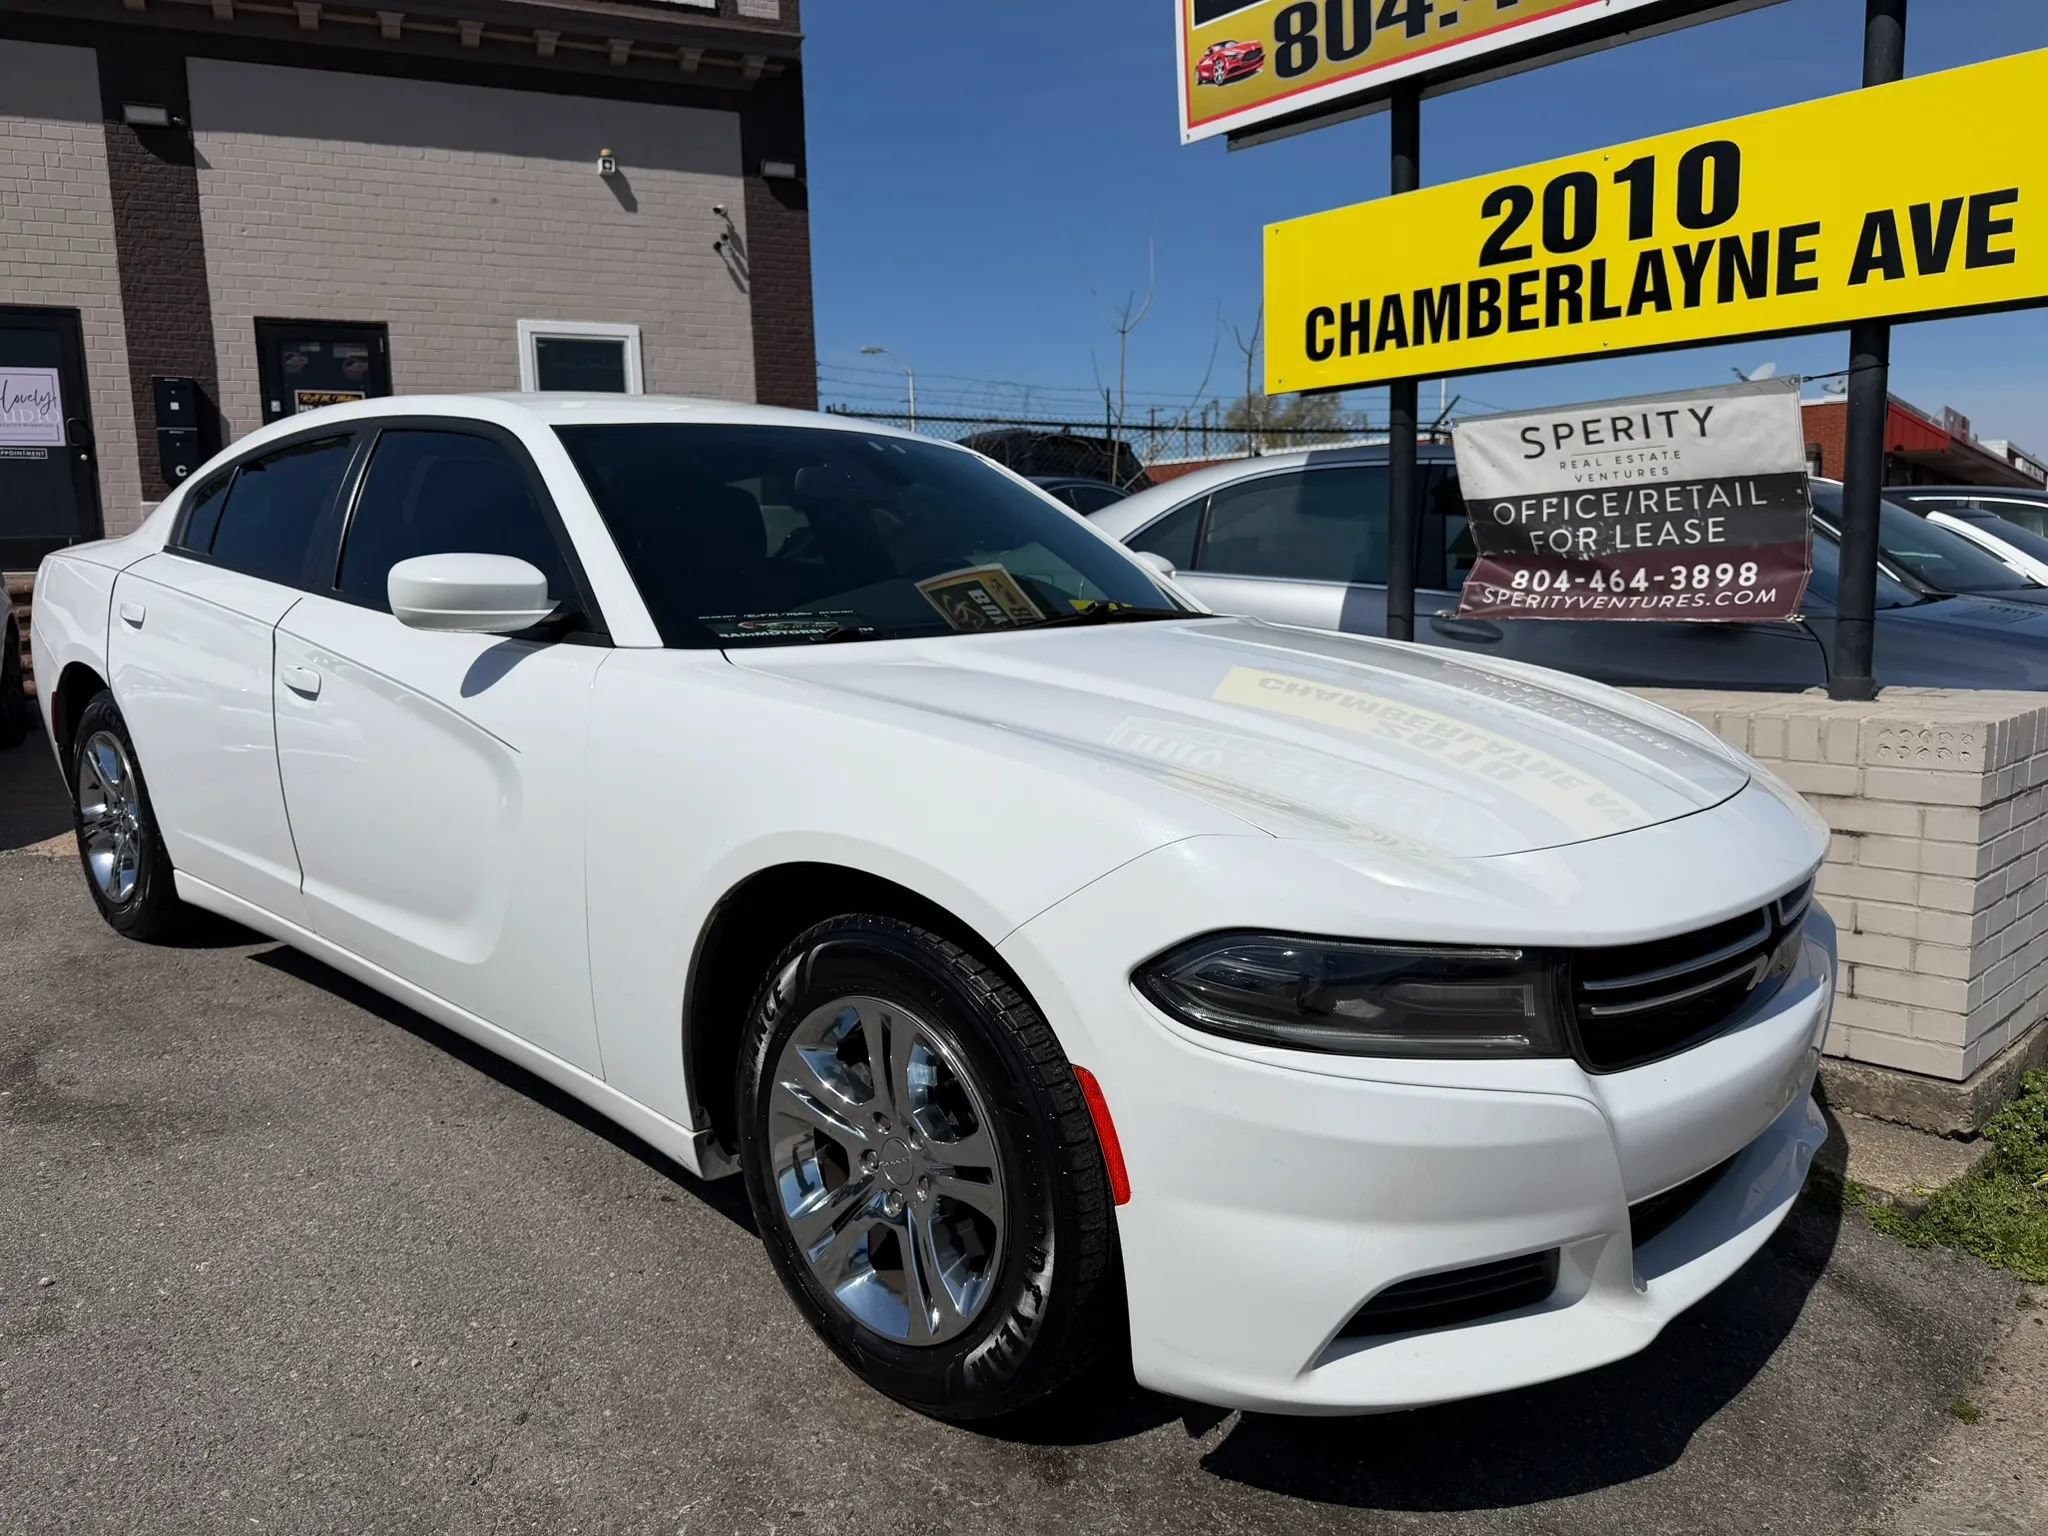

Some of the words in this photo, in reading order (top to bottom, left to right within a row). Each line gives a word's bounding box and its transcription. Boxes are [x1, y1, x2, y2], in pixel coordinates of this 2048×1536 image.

[1274, 0, 1518, 79] 804.
[1479, 141, 1741, 267] 2010
[1304, 221, 1821, 362] CHAMBERLAYNE
[1847, 187, 2020, 286] AVE
[1520, 405, 1714, 460] SPERITY
[0, 450, 45, 458] PPOINTMENT
[1559, 458, 1603, 471] REAL
[1615, 450, 1682, 465] ESTATE
[175, 465, 187, 477] C
[1574, 467, 1670, 483] VENTURES
[1493, 481, 1768, 526] OFFICE/RETAIL
[1529, 527, 1597, 553] FOR
[1615, 517, 1726, 549] LEASE
[1511, 562, 1759, 593] 804-464-3898
[1482, 588, 1777, 609] SPERITYVENTURES.COM
